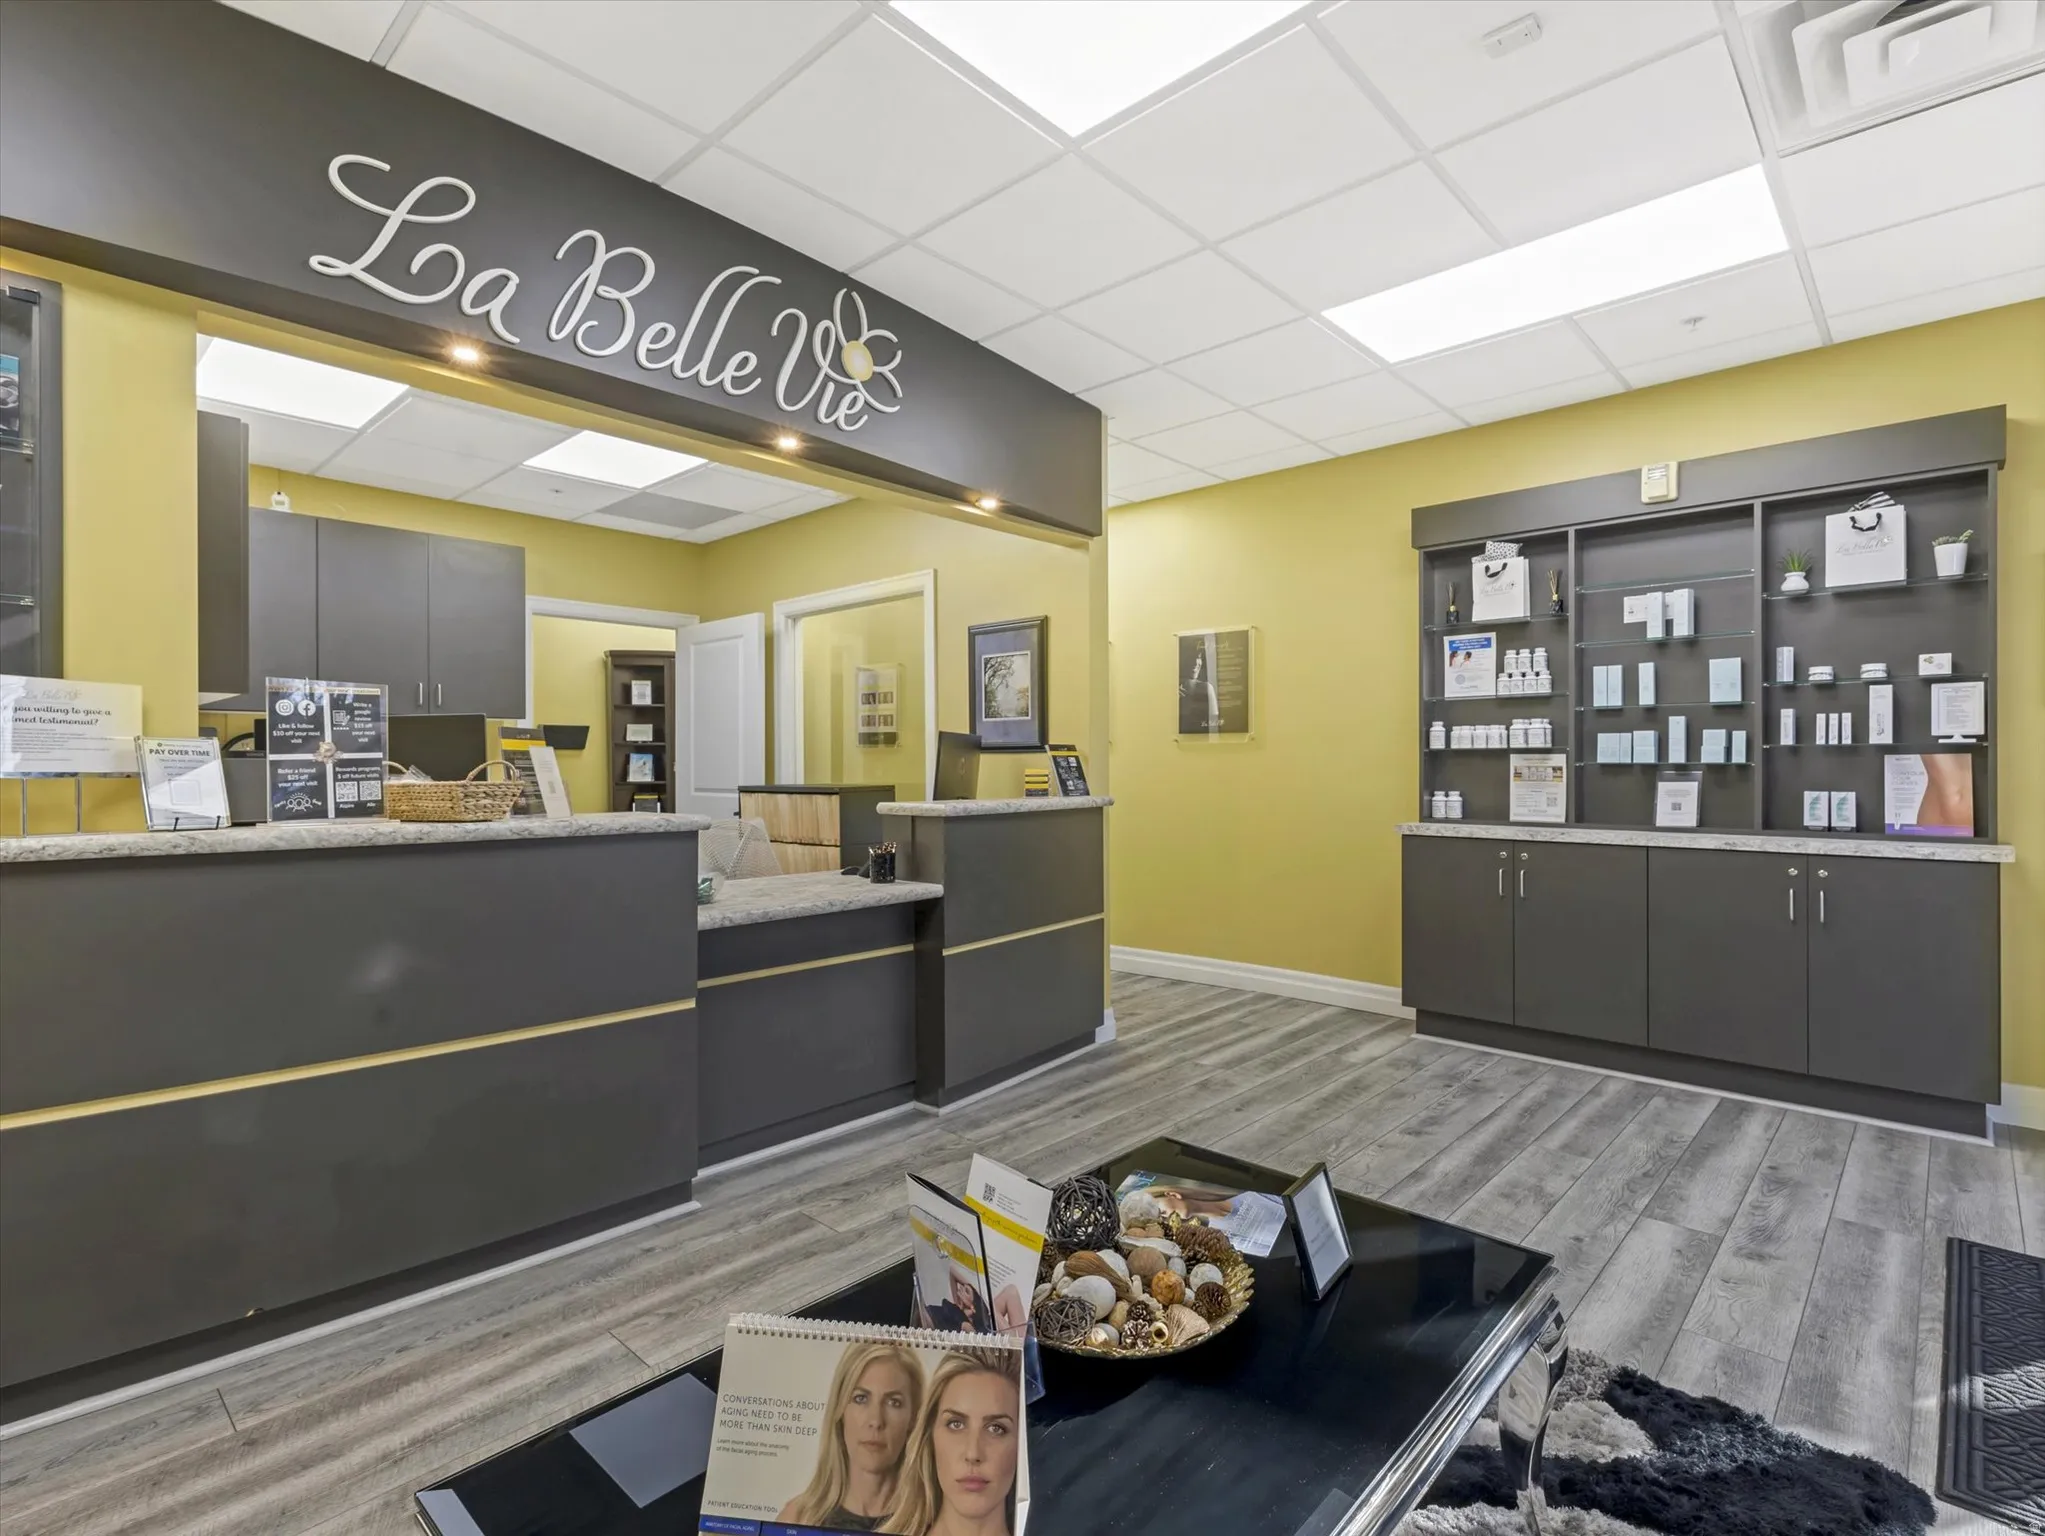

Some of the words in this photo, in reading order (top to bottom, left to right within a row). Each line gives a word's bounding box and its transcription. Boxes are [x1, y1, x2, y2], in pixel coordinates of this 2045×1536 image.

[308, 154, 520, 343] La
[547, 229, 782, 397] Belle
[770, 307, 870, 431] Vie
[14, 705, 31, 713] you
[33, 705, 69, 716] willing
[71, 706, 81, 715] to
[83, 707, 102, 717] give
[39, 716, 99, 726] testimonial?
[191, 749, 210, 757] TIME
[722, 1394, 794, 1409] CONVERSATIONS
[795, 1401, 825, 1411] ABOUT
[721, 1406, 749, 1417] AGING
[751, 1409, 775, 1420] NEED
[777, 1412, 789, 1421] TO
[791, 1413, 803, 1422] BE
[719, 1420, 744, 1430] MORE
[747, 1422, 771, 1432] THAN
[773, 1424, 792, 1434] SKIN
[795, 1426, 818, 1436] DEEP
[707, 1500, 730, 1508] PATIENT
[730, 1502, 763, 1512] EDUCATION
[763, 1505, 778, 1513] TOOL
